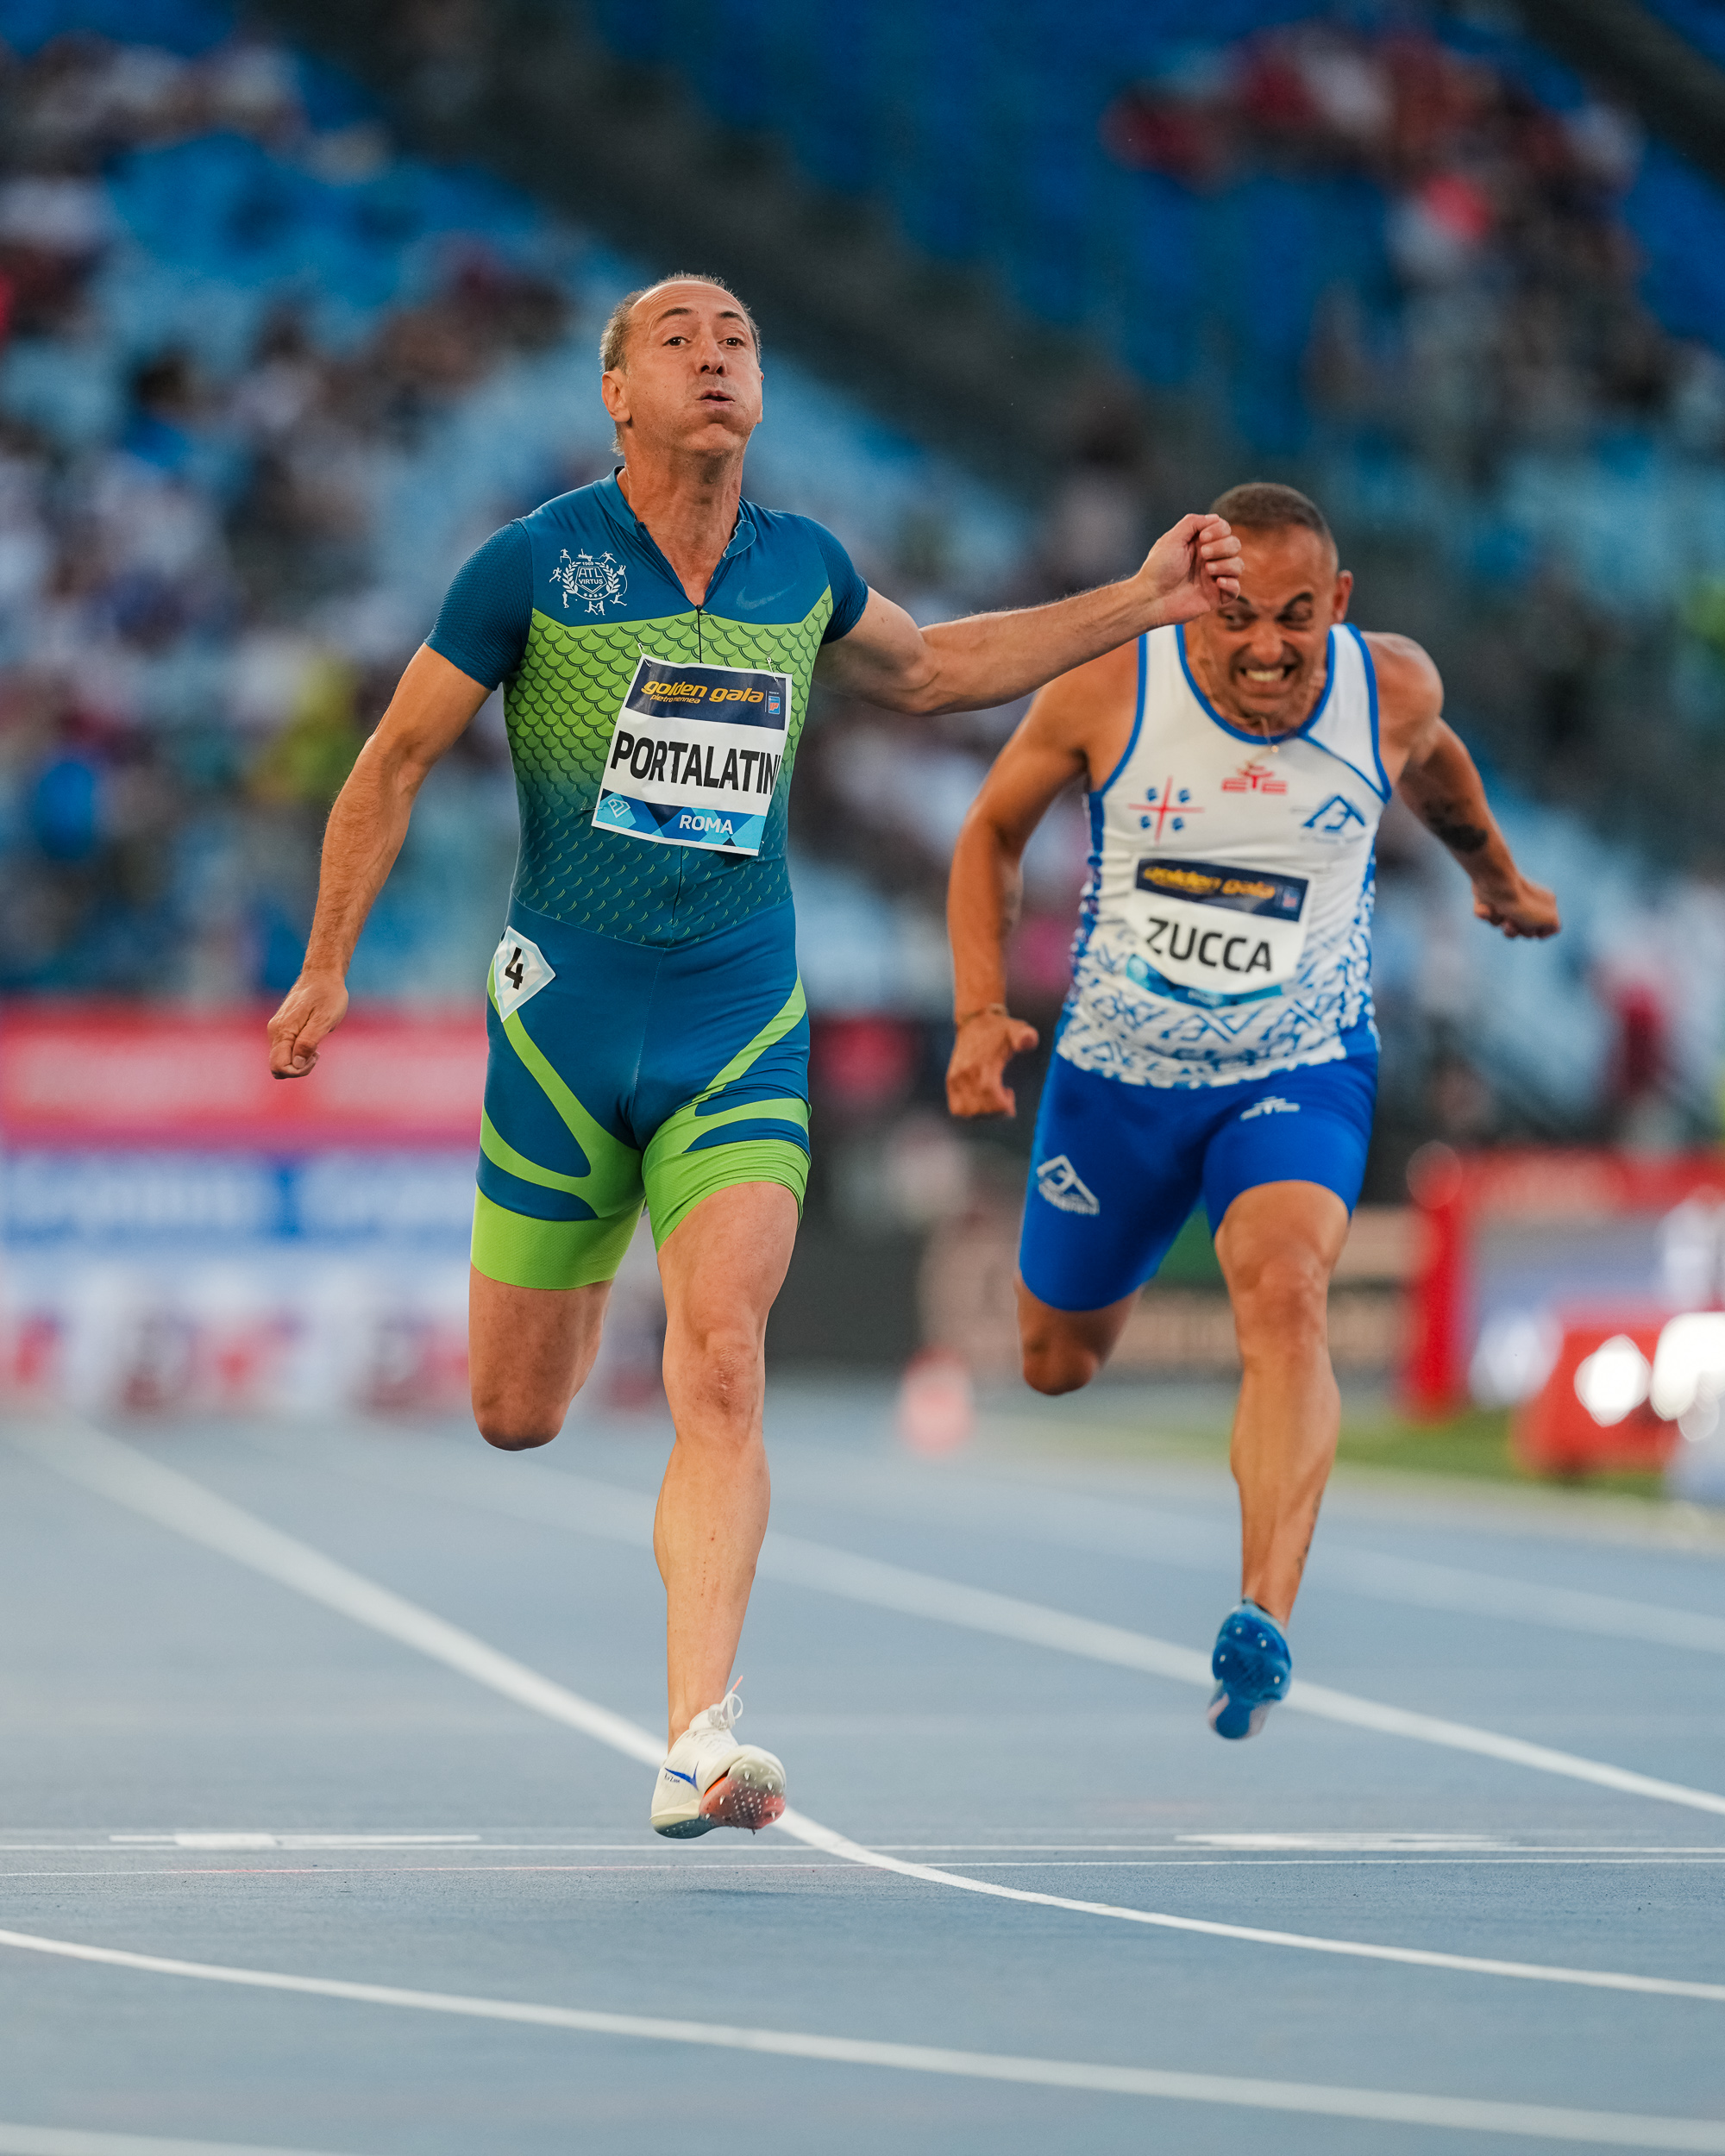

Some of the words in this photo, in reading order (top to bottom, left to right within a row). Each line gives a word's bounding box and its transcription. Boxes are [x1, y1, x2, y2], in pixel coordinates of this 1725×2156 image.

[578, 567, 602, 578] ATL
[641, 680, 708, 698] golden
[709, 687, 765, 703] gala
[679, 814, 734, 835] ROMA
[1146, 917, 1273, 974] ZUCCA
[505, 946, 524, 990] 4
